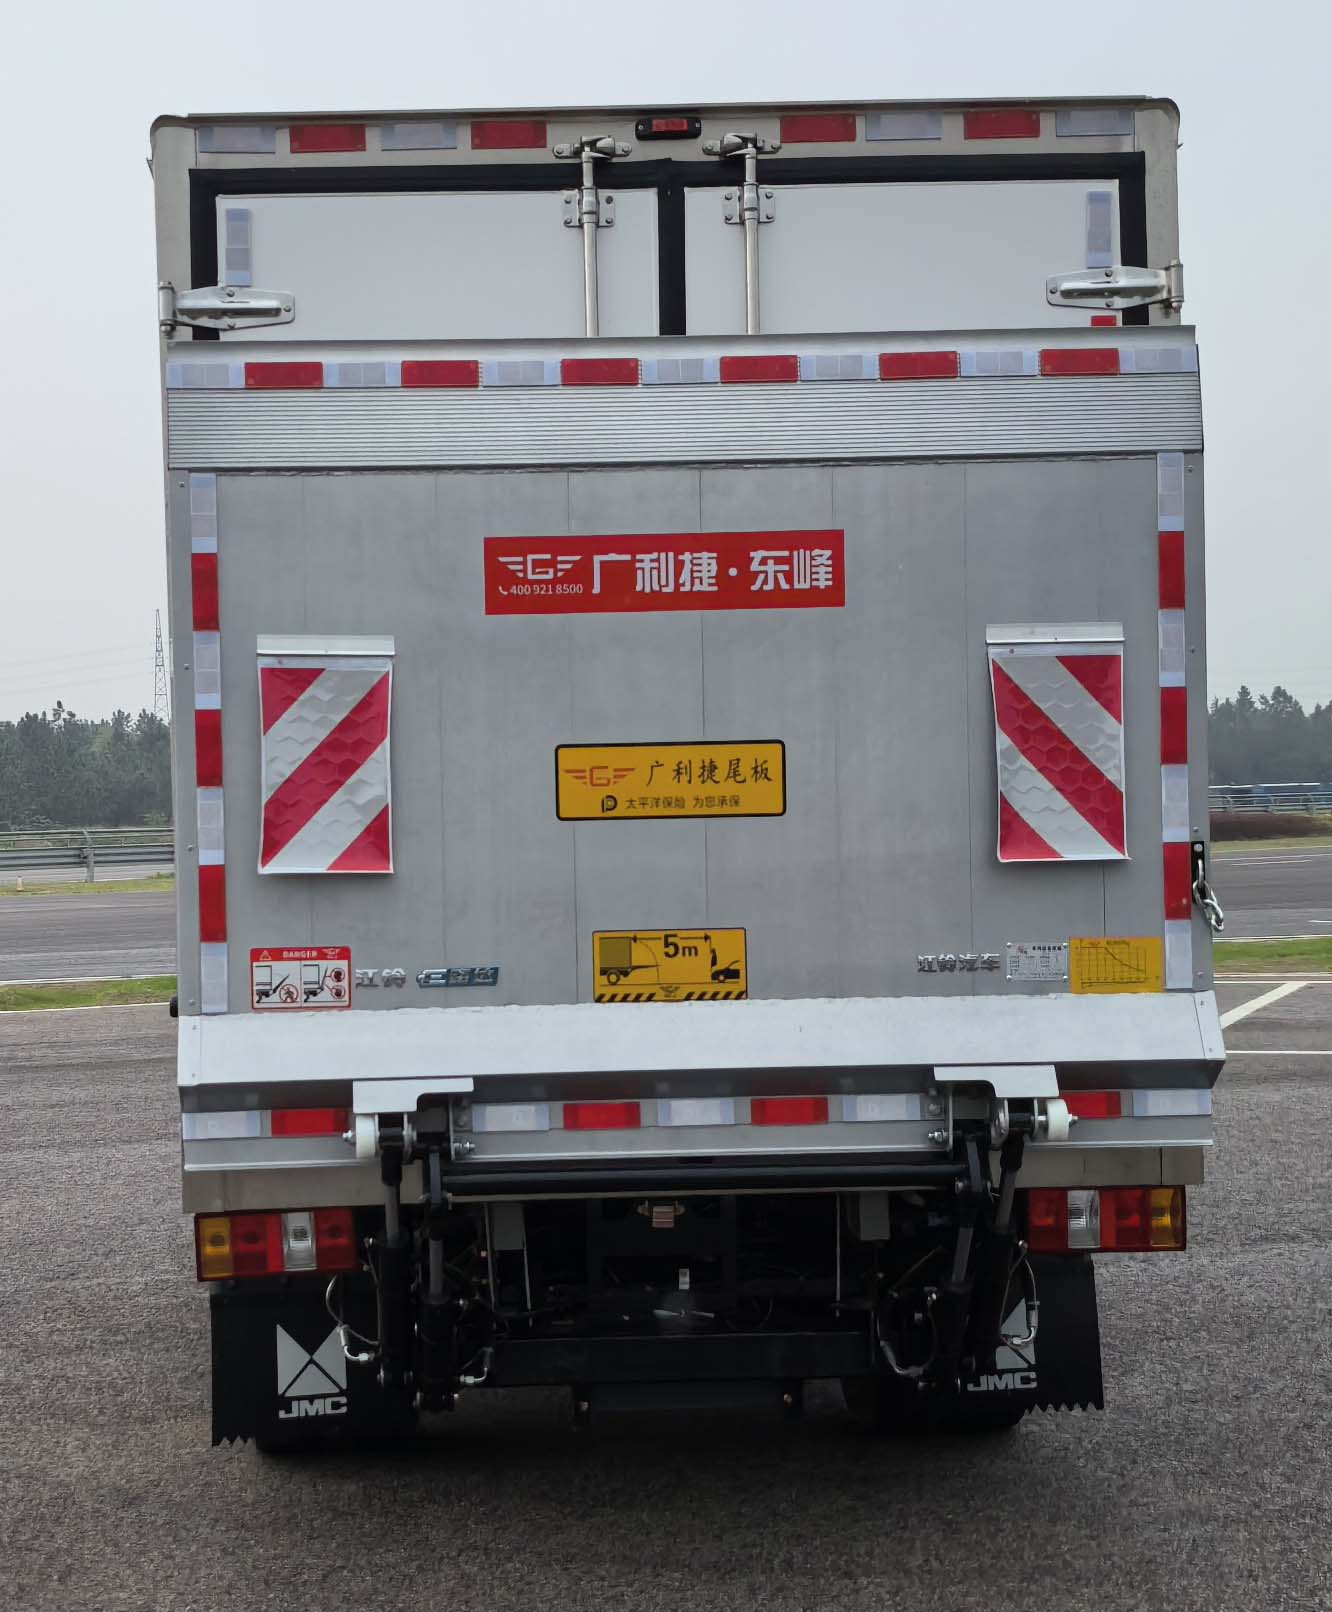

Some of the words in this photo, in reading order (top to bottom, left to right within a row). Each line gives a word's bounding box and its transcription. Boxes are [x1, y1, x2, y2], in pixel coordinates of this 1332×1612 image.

[510, 584, 532, 596] 400
[533, 584, 553, 595] 921
[555, 583, 584, 594] 8500
[646, 757, 774, 787] 广利捷尾板
[282, 950, 319, 959] DANGER
[664, 934, 698, 958] 5m
[917, 952, 1001, 973] 江铃汽车
[966, 1371, 1038, 1392] JMC
[278, 1396, 348, 1419] JMC
